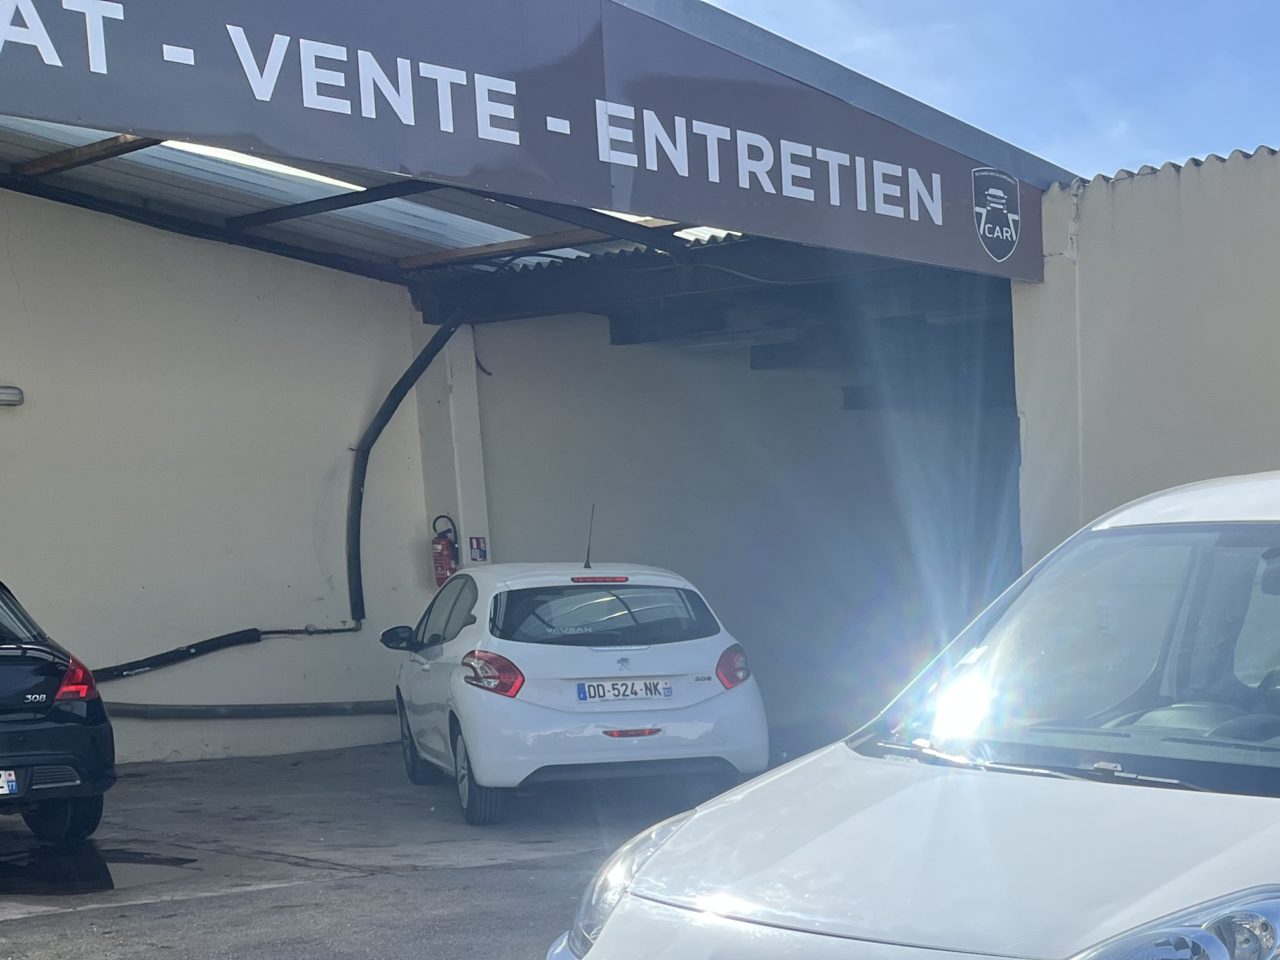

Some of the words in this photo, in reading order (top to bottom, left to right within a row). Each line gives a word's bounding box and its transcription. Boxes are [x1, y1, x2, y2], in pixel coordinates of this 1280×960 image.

[226, 23, 521, 146] VENTE
[595, 99, 944, 226] ENTRETIEN
[24, 694, 47, 703] 308
[587, 681, 662, 699] DD-524-NK
